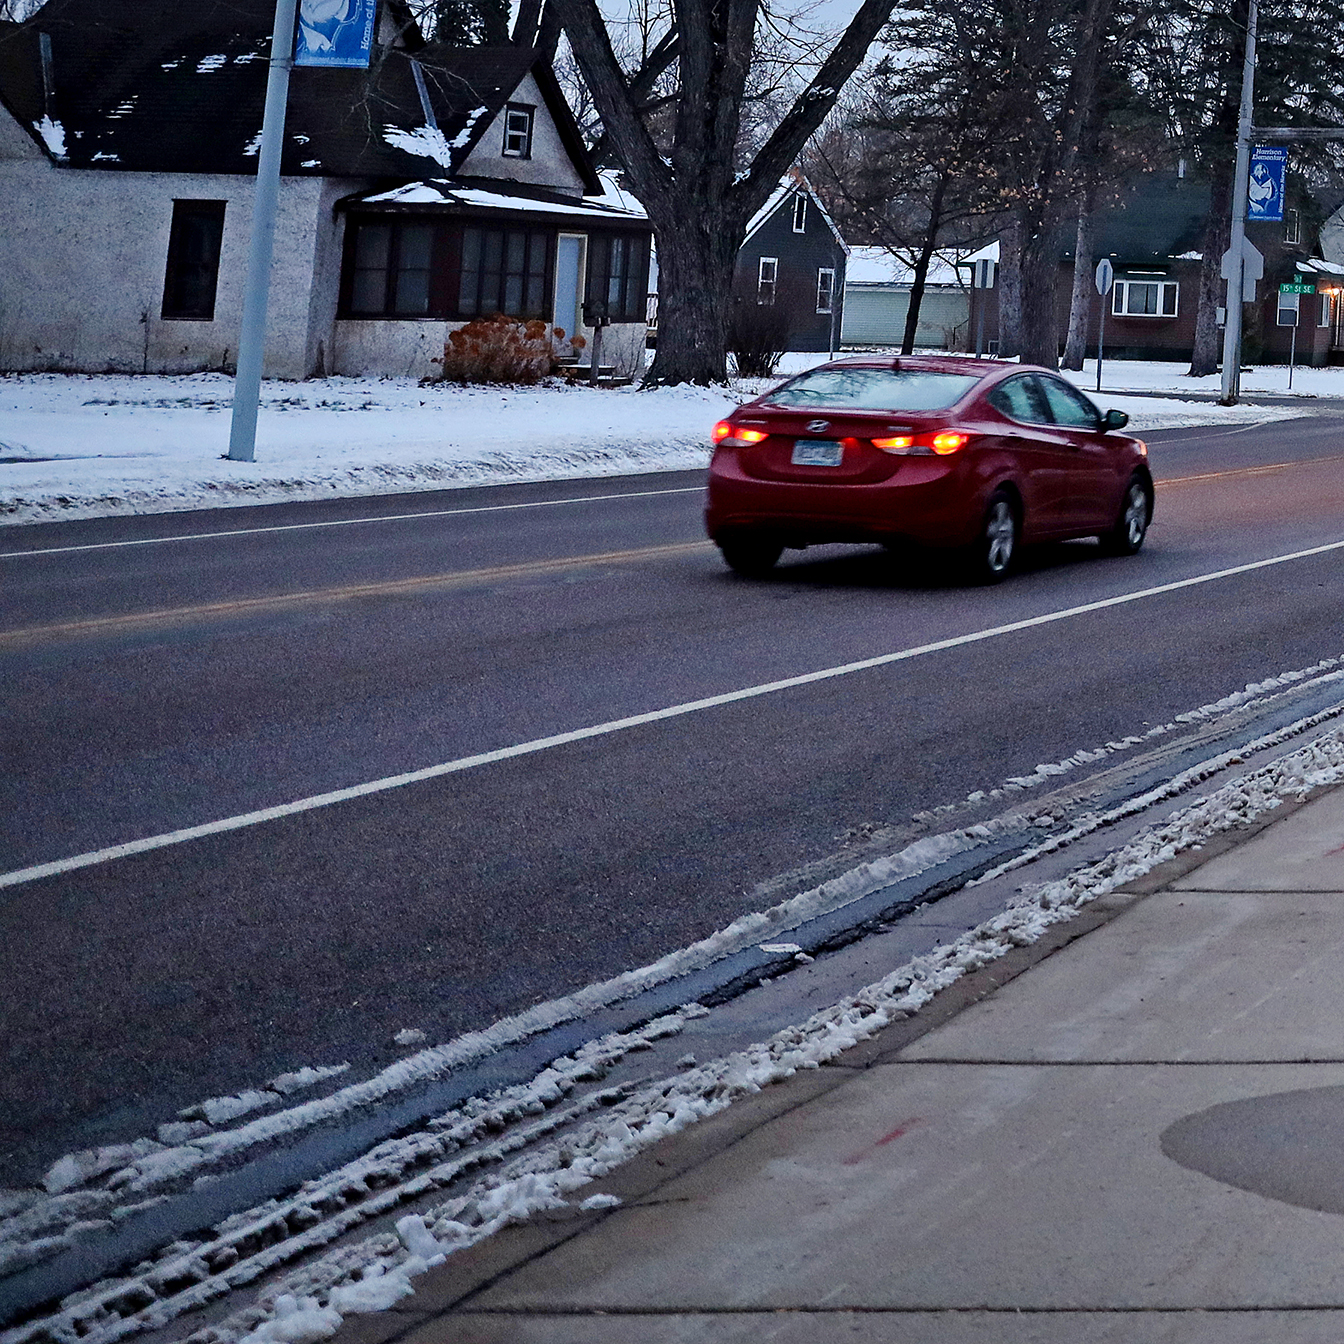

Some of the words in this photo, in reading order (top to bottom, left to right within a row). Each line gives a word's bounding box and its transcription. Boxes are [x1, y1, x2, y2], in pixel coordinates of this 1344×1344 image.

[366, 5, 375, 19] of
[360, 20, 373, 50] Home
[1252, 154, 1286, 162] Elementary
[1303, 285, 1311, 293] SE
